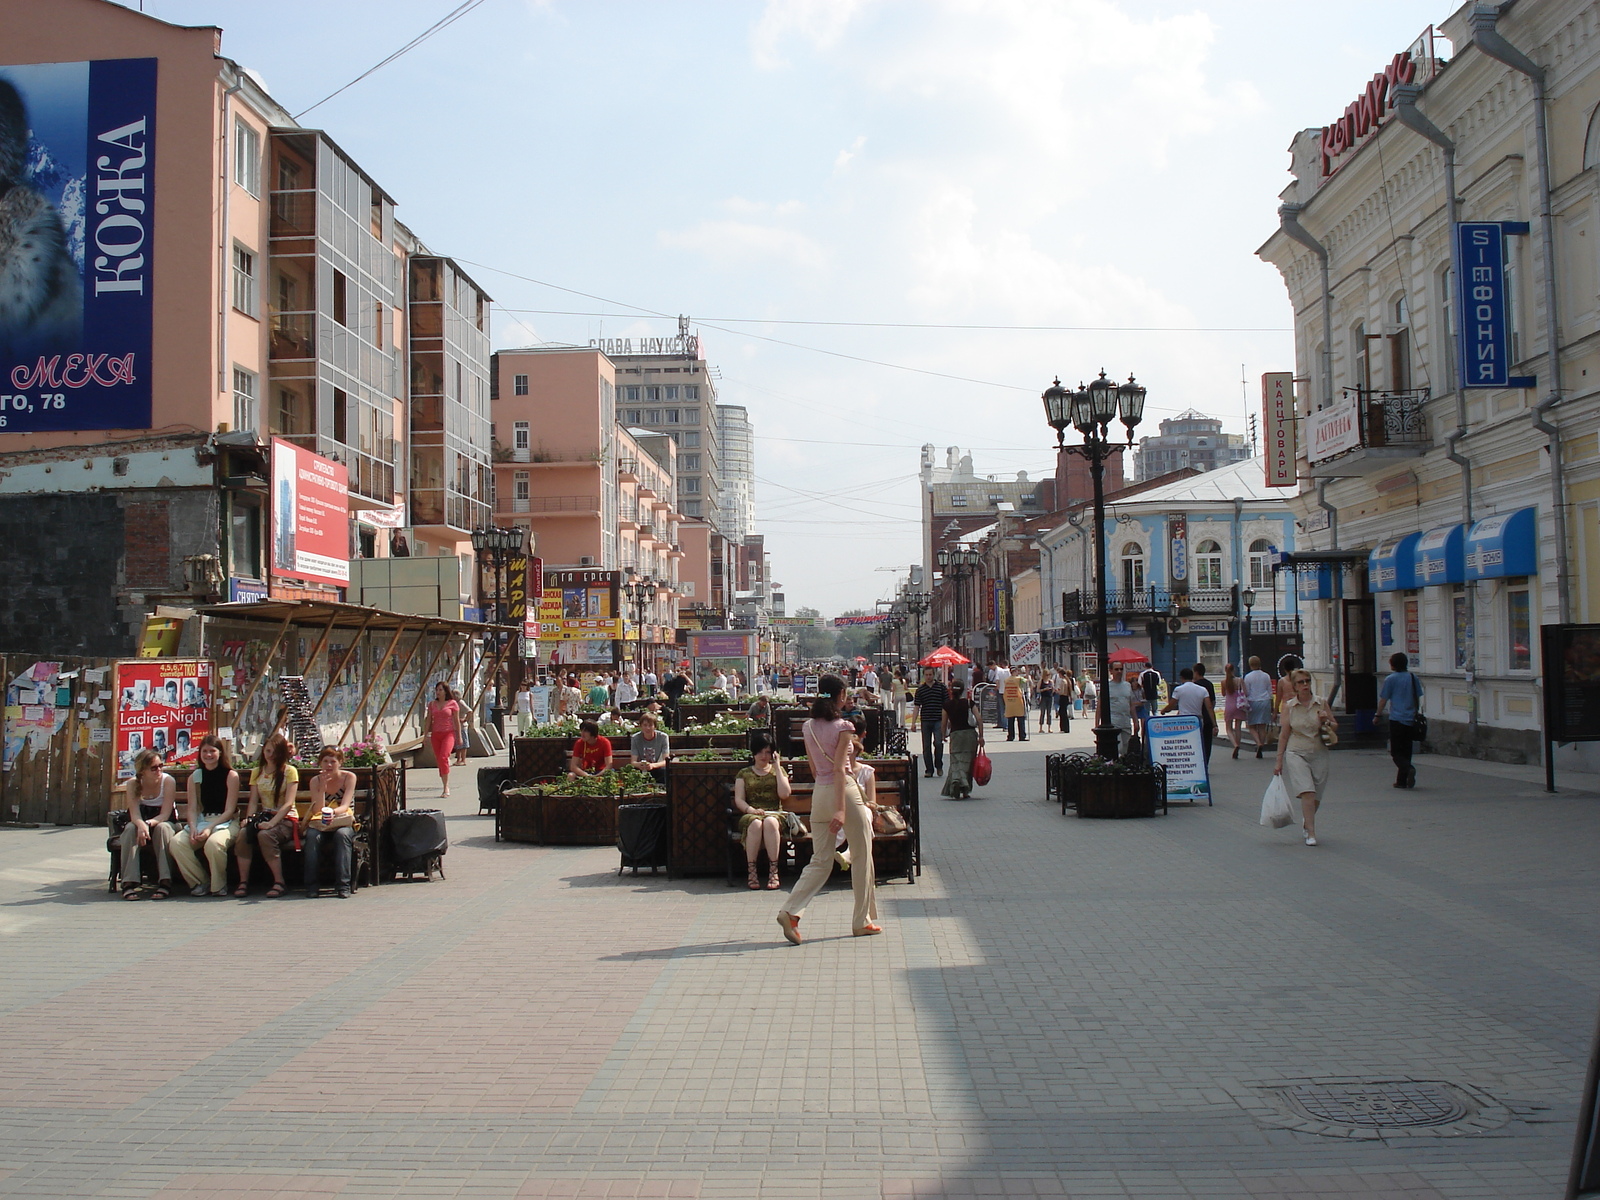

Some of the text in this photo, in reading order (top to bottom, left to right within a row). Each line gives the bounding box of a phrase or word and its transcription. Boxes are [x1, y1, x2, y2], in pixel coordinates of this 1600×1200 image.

[95, 116, 146, 297] КОЖА
[11, 353, 136, 390] МЕХА
[41, 393, 66, 409] 78
[1275, 380, 1287, 478] КАНЦТОВАРЫ
